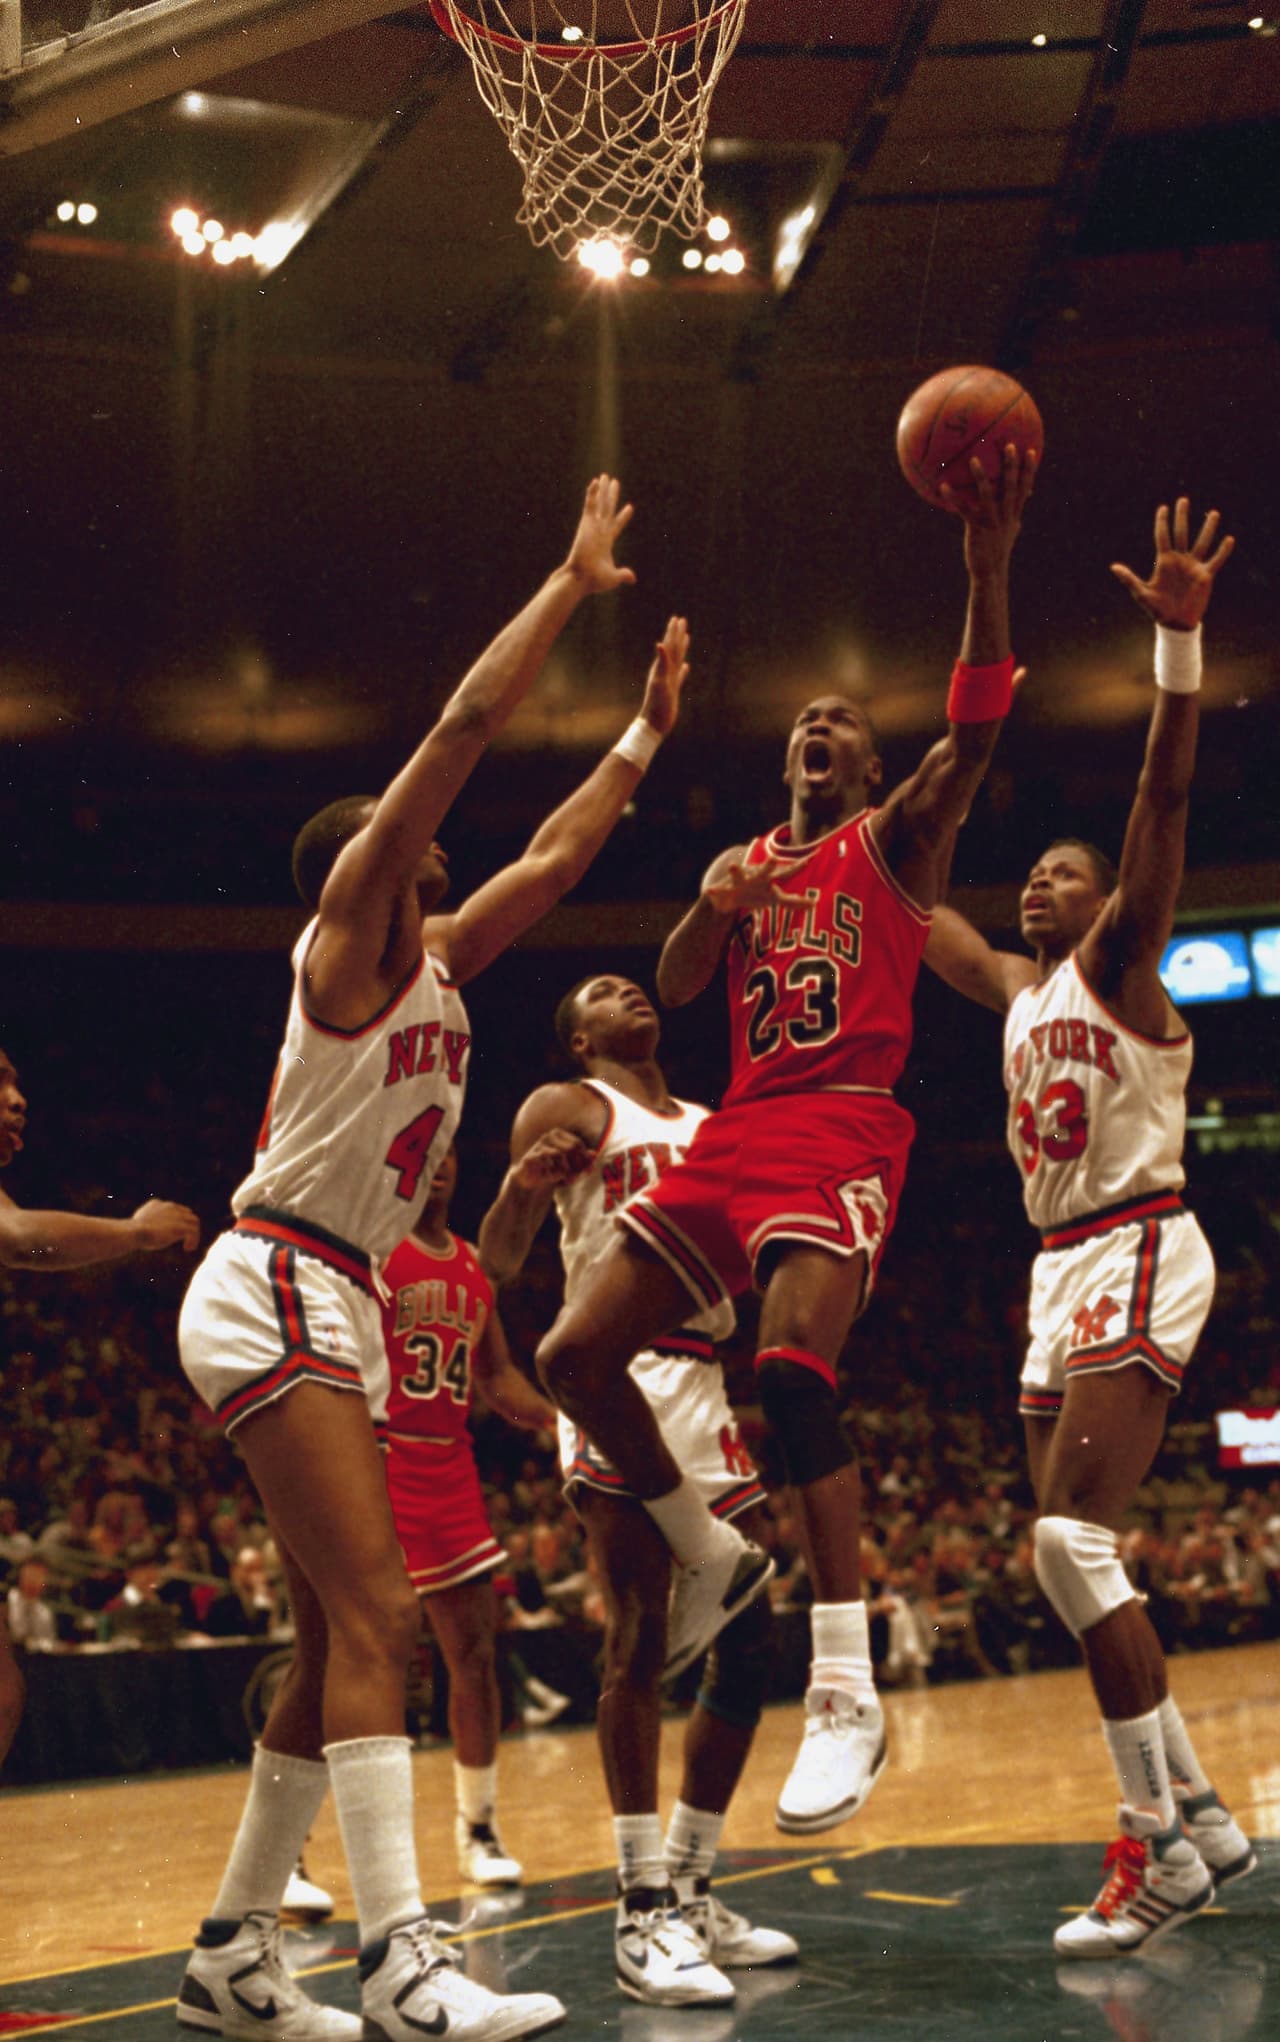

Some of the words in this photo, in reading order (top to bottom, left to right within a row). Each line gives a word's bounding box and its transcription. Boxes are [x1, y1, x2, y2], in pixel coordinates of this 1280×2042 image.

[743, 955, 840, 1063] 23
[1029, 1018, 1121, 1084] YORK
[384, 1103, 445, 1202] 4
[400, 1331, 473, 1406] 34
